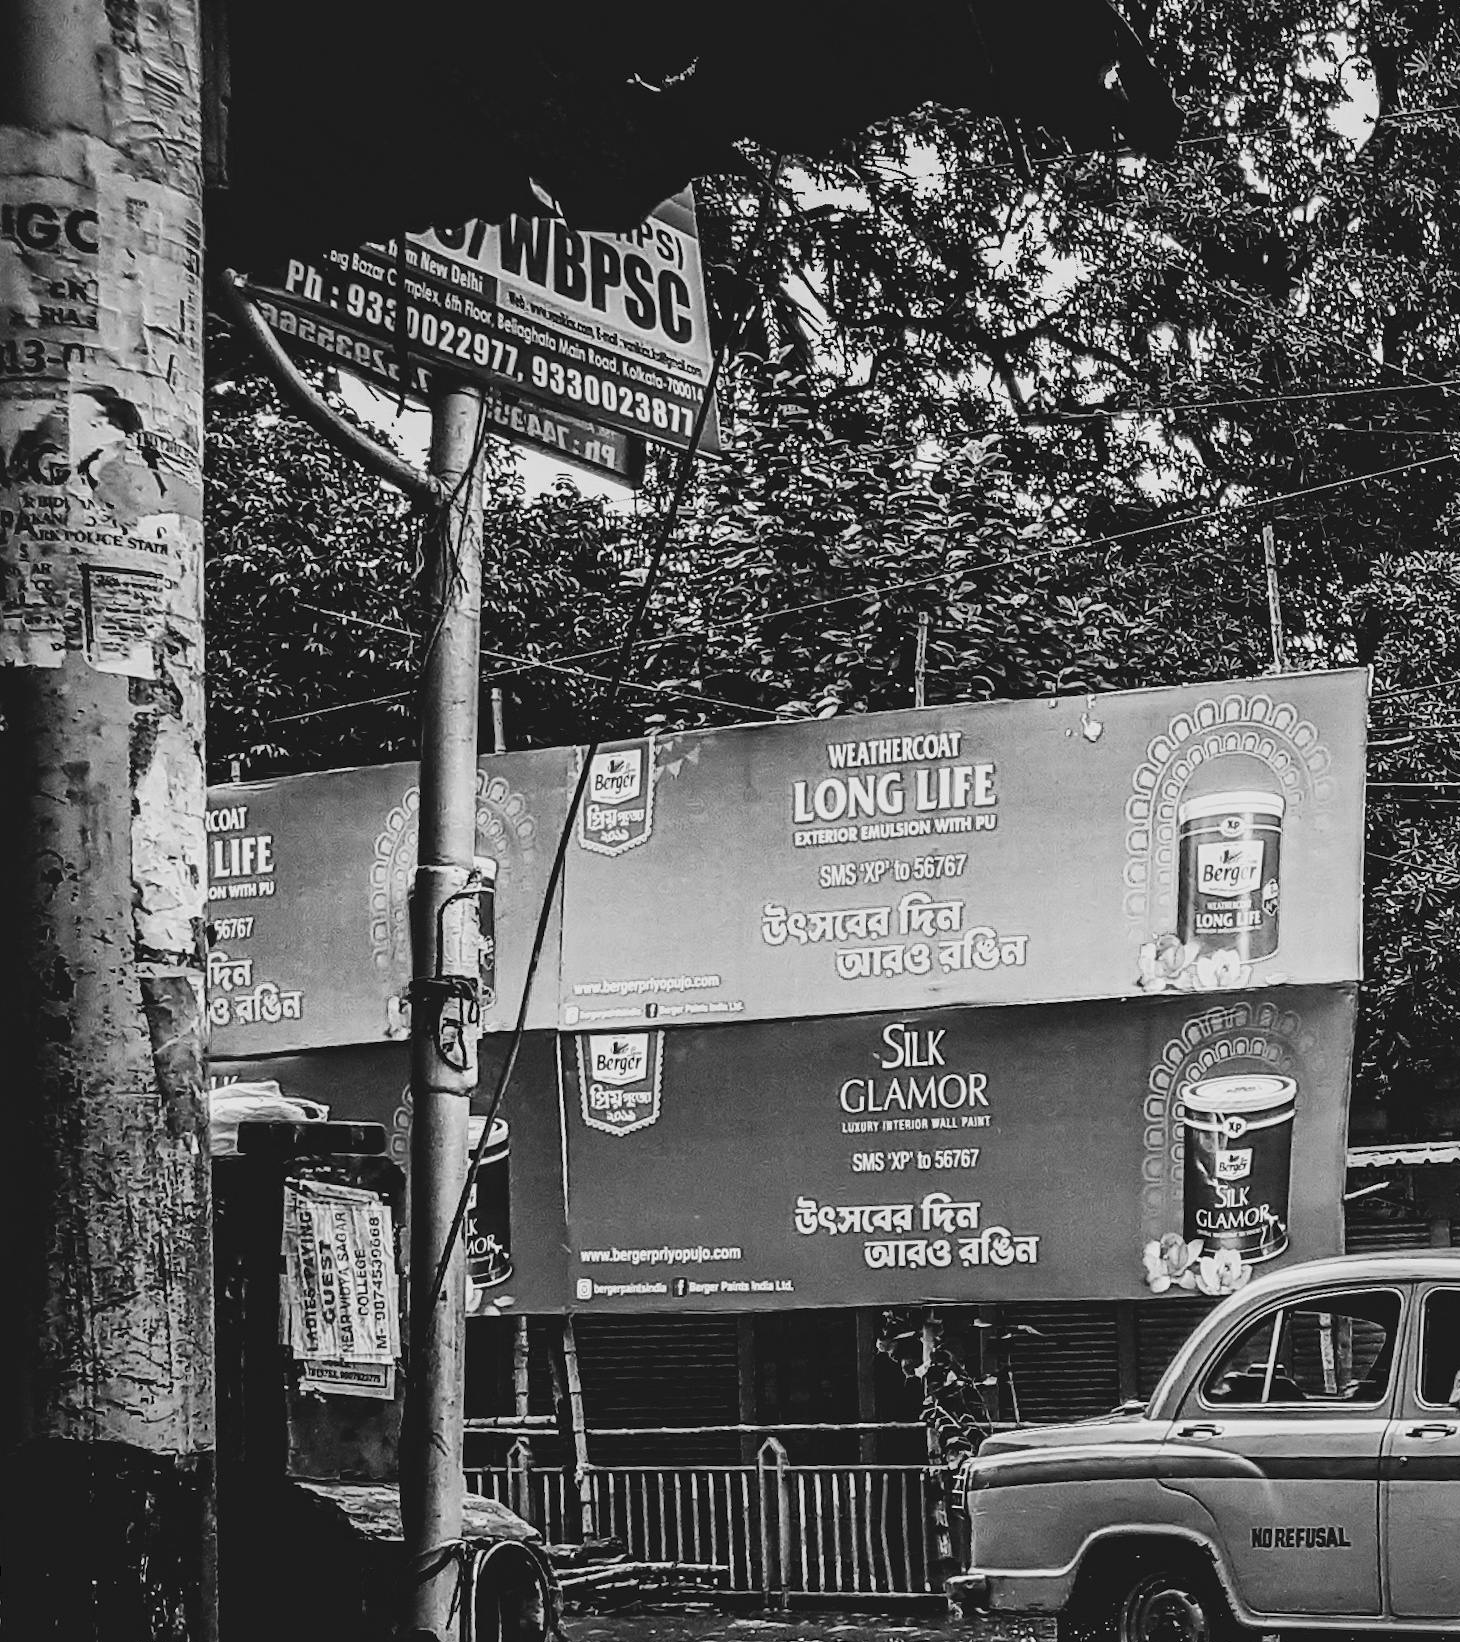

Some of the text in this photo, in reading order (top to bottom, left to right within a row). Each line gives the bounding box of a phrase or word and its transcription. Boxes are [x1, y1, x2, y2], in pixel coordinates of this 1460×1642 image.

[420, 251, 449, 280] New
[451, 267, 484, 295] Delhi
[558, 338, 586, 363] Main
[532, 355, 694, 439] 9330023877
[827, 731, 962, 769] WEATHERCOAT
[594, 774, 636, 795] Berger
[793, 763, 996, 823] LONG LIFE
[794, 813, 997, 847] EXTERIOR EMULSION WITH PU
[209, 836, 274, 878] LIFE
[818, 864, 856, 888] SMS
[894, 859, 910, 880] to
[913, 853, 967, 880] 56767
[1203, 863, 1257, 887] Berger
[762, 891, 963, 947] উৎসবের দিন
[1195, 911, 1234, 929] LONG
[836, 927, 1029, 979] আরও রঙিন
[234, 982, 303, 1024] রঙিন
[597, 1054, 642, 1076] Berger
[839, 1073, 989, 1114] GLAMOR
[841, 1115, 990, 1134] LUXURY INTERIOR WALL PAINT
[851, 1152, 884, 1173] SMS
[917, 1149, 931, 1170] to
[934, 1148, 979, 1170] 56767
[793, 1191, 981, 1236] উৎসবের দিন
[1196, 1203, 1270, 1229] GLAMOR
[580, 1246, 742, 1265] www.bergerpriyopujo.com
[864, 1225, 1039, 1271] আরও রঙিন
[319, 1240, 336, 1326] GUEST
[354, 1248, 369, 1317] COLLEGE
[688, 1281, 719, 1296] Berger
[1251, 1526, 1351, 1548] NO REFUSAL
